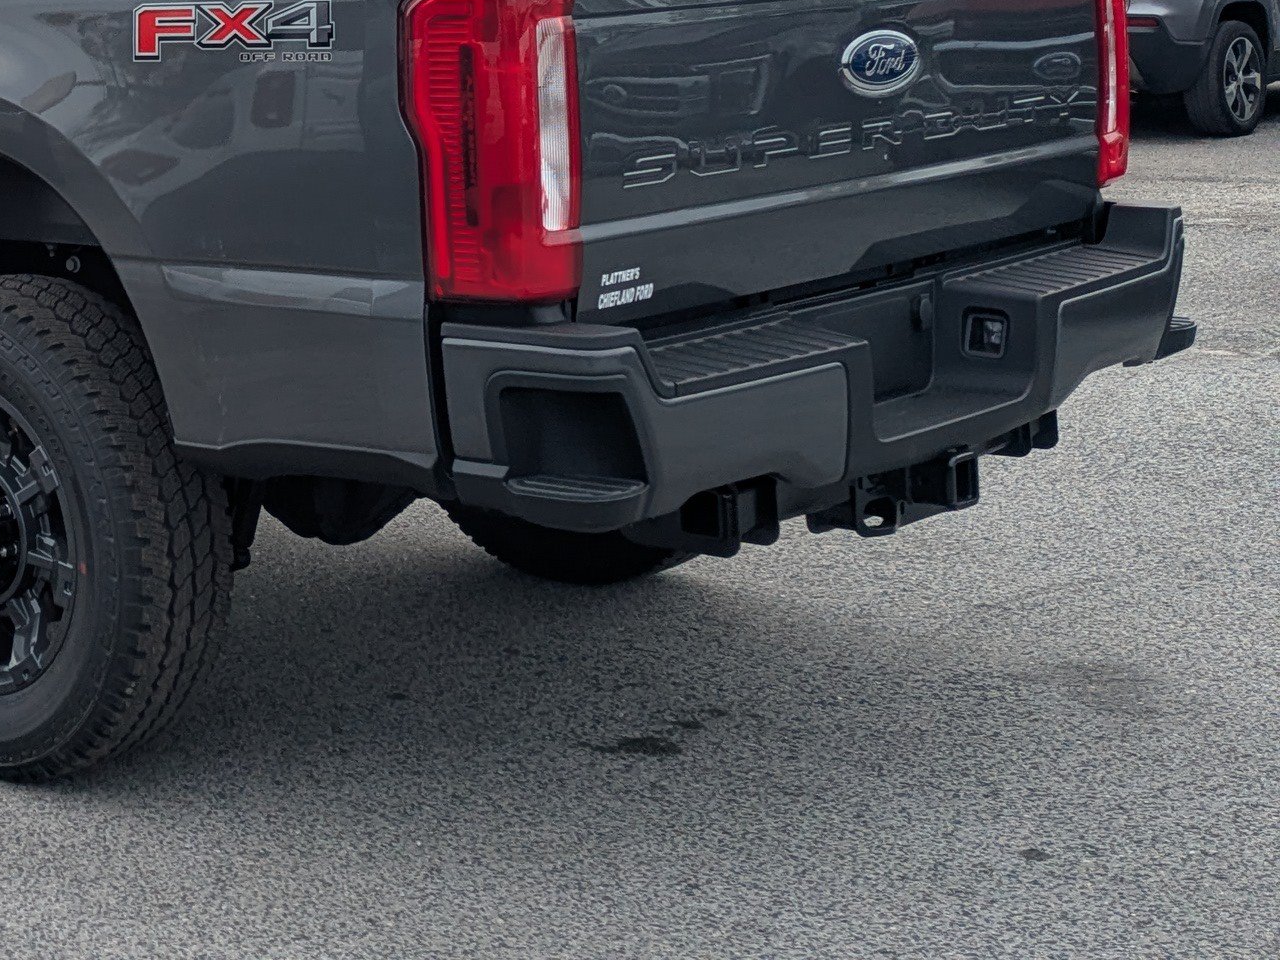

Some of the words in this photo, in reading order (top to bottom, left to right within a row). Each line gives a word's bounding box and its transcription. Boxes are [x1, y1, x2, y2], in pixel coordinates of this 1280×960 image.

[133, 0, 335, 62] FX4
[239, 52, 276, 62] OFF
[282, 52, 332, 62] ROAD
[865, 43, 906, 77] Ford
[622, 115, 902, 189] SUPER
[598, 287, 635, 310] CHIEFLAND
[634, 282, 654, 302] FORD
